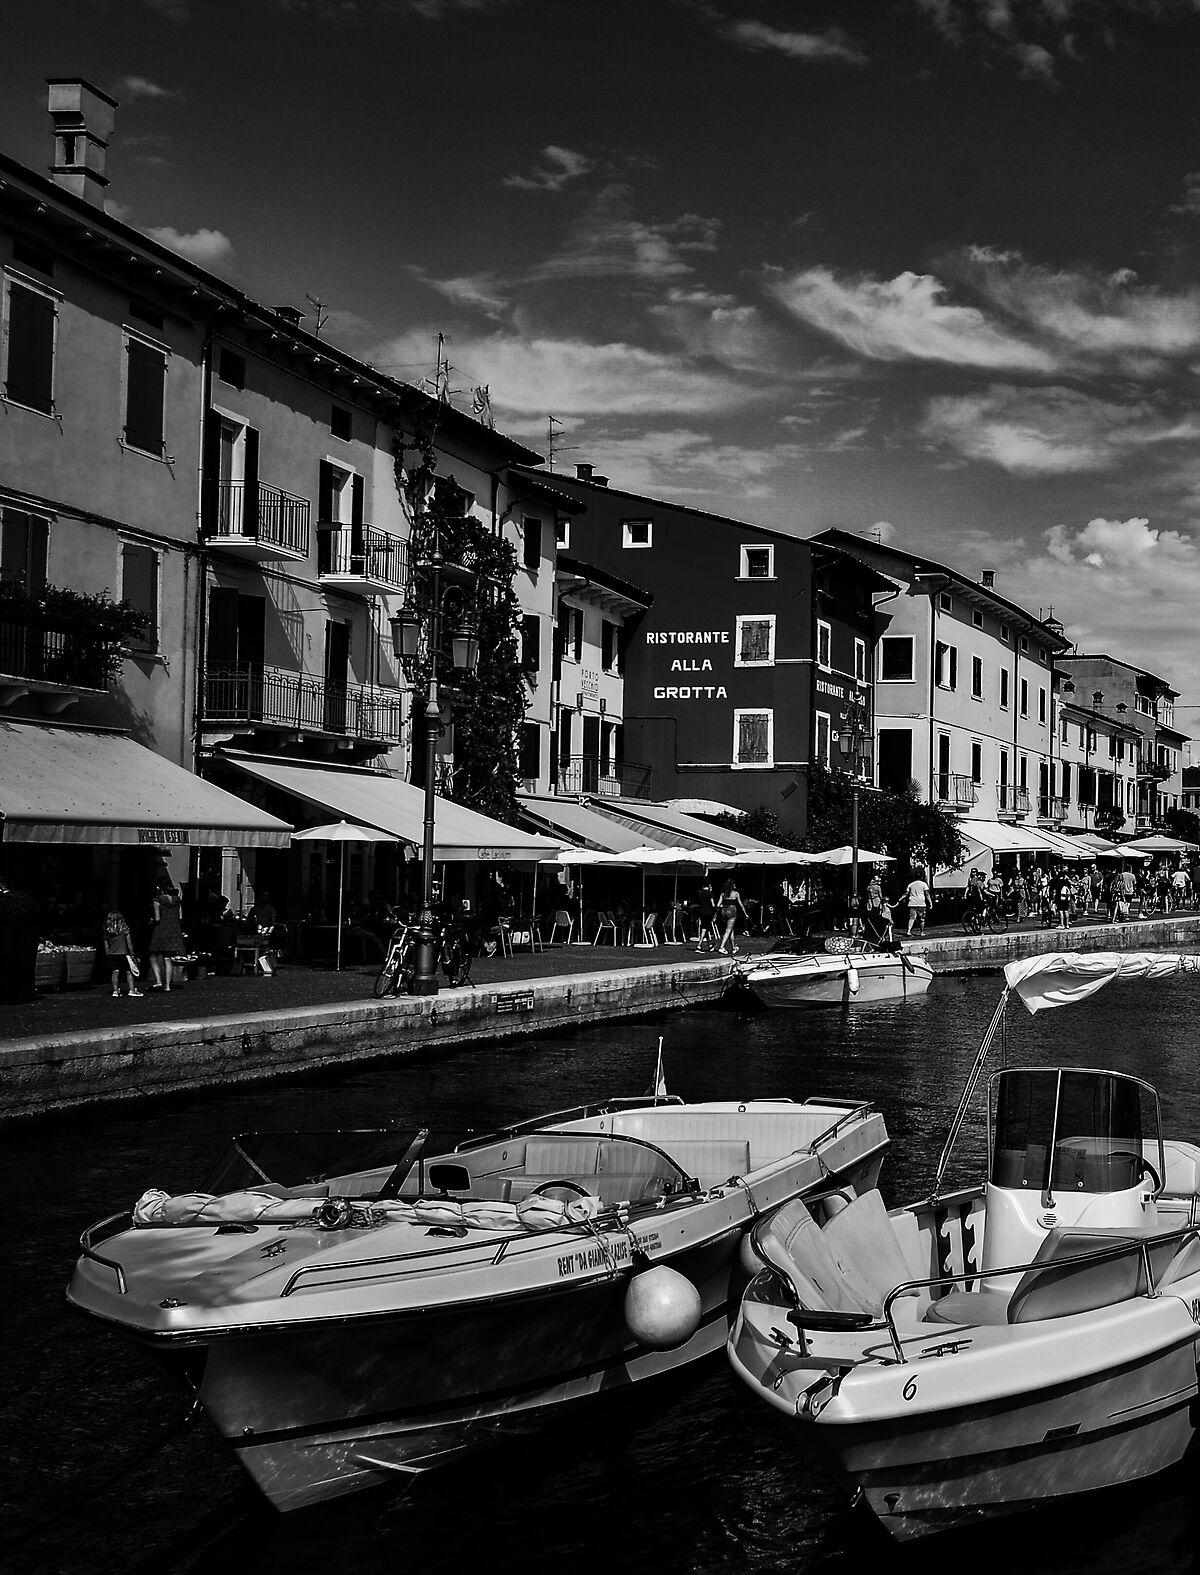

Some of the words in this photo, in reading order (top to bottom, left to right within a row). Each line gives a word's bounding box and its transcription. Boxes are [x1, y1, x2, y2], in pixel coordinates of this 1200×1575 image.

[646, 632, 730, 644] RISTORANTE
[671, 659, 713, 671] ALLA
[654, 686, 728, 699] GROTTA
[816, 680, 844, 699] RISTORANTE
[557, 1255, 575, 1277] RENT
[902, 1374, 918, 1401] 6
